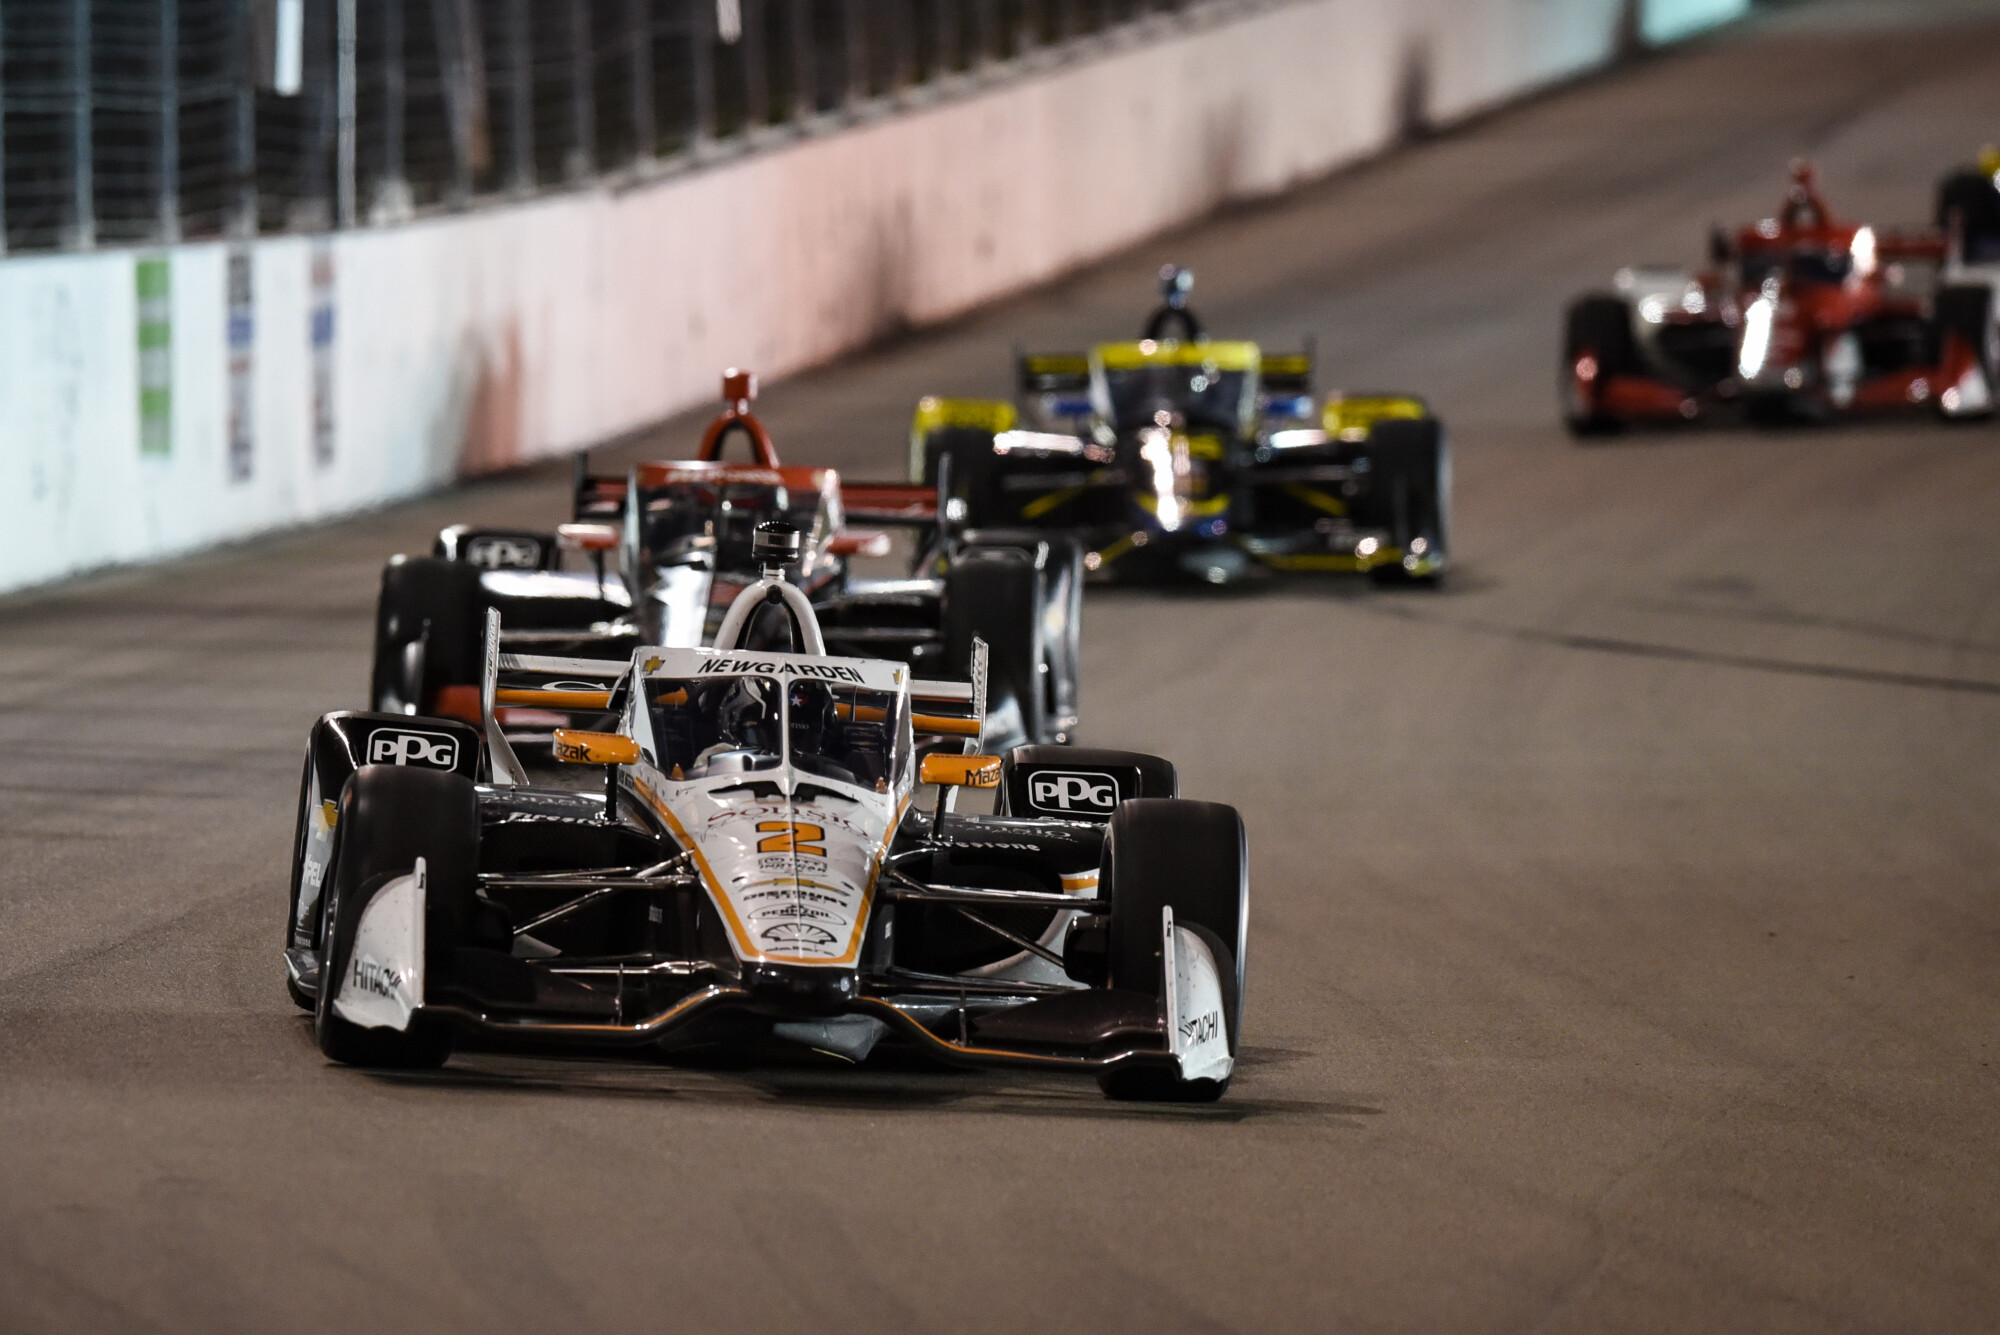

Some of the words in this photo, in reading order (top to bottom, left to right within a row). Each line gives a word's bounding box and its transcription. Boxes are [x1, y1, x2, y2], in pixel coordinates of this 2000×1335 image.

[697, 658, 866, 684] NEWGARDEN
[373, 735, 453, 766] PPG
[1034, 776, 1114, 809] PPG
[755, 820, 827, 857] 2
